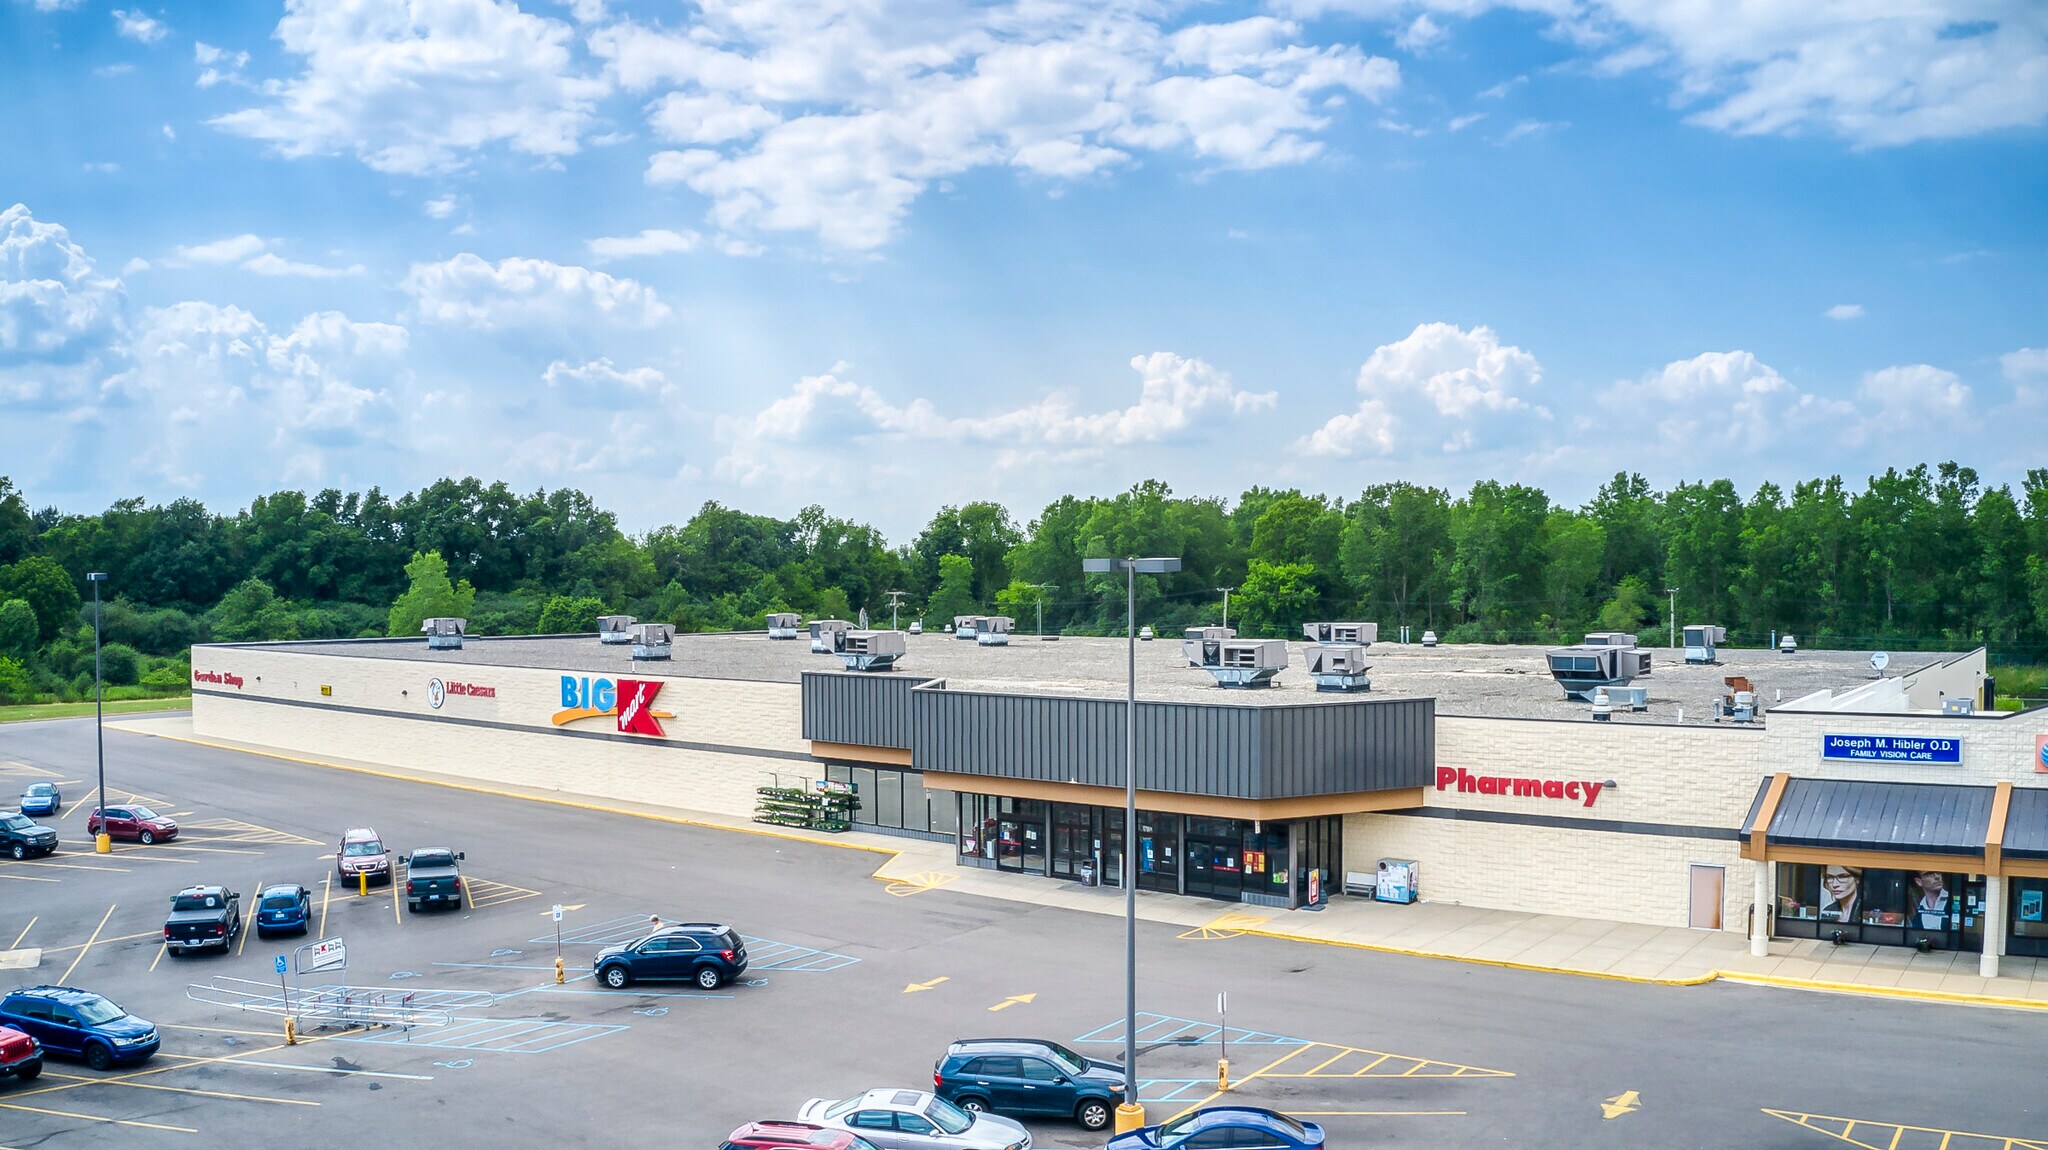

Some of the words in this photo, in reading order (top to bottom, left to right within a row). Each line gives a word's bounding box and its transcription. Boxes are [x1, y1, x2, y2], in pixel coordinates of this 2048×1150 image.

[194, 670, 222, 684] Garden
[224, 672, 243, 689] Shop
[446, 681, 466, 695] Little
[560, 675, 616, 713] BIG
[617, 679, 665, 736] K
[619, 683, 646, 730] mart
[1830, 737, 1871, 749] Joseph
[1875, 738, 1888, 748] M.
[1893, 739, 1925, 750] Hibler
[1930, 740, 1953, 751] O.D.
[1850, 749, 1877, 757] FAMILY
[1880, 751, 1907, 759] VISION
[1910, 752, 1932, 760] CARE
[1436, 766, 1604, 807] Pharmacy
